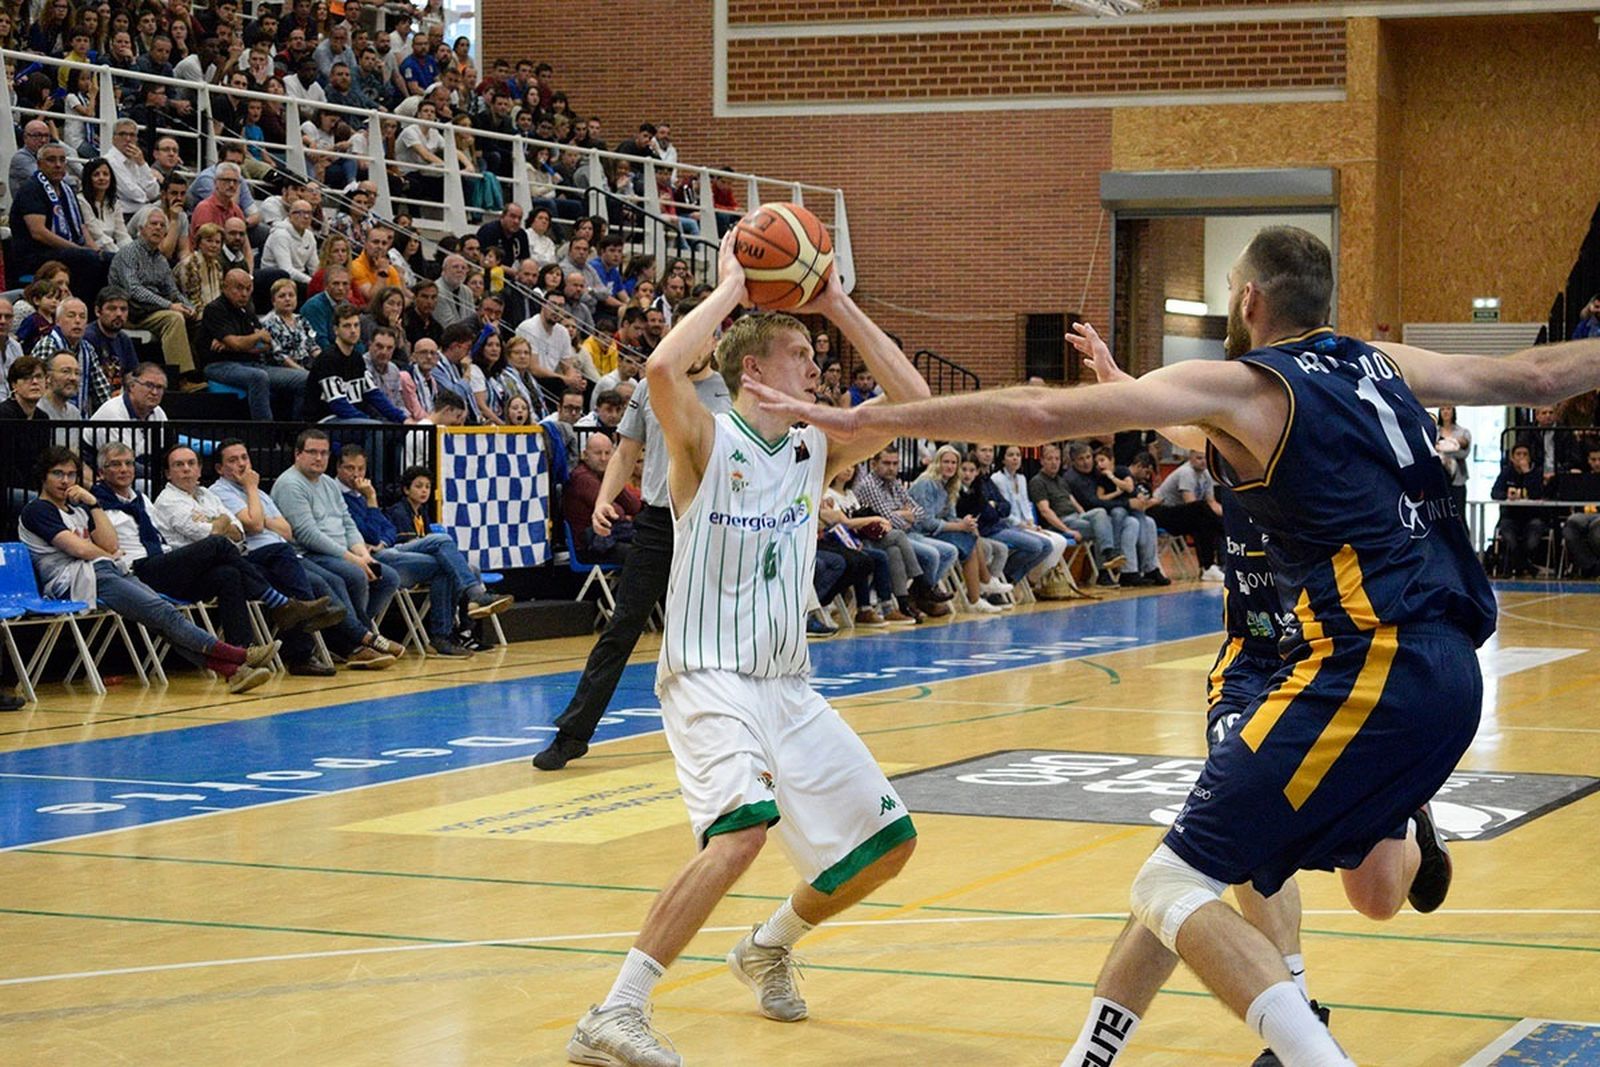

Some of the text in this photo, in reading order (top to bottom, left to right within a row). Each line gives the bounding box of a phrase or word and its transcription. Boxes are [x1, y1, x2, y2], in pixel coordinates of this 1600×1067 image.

[709, 510, 776, 532] energía
[35, 736, 545, 814] Deporte
[956, 754, 1139, 786] ORO
